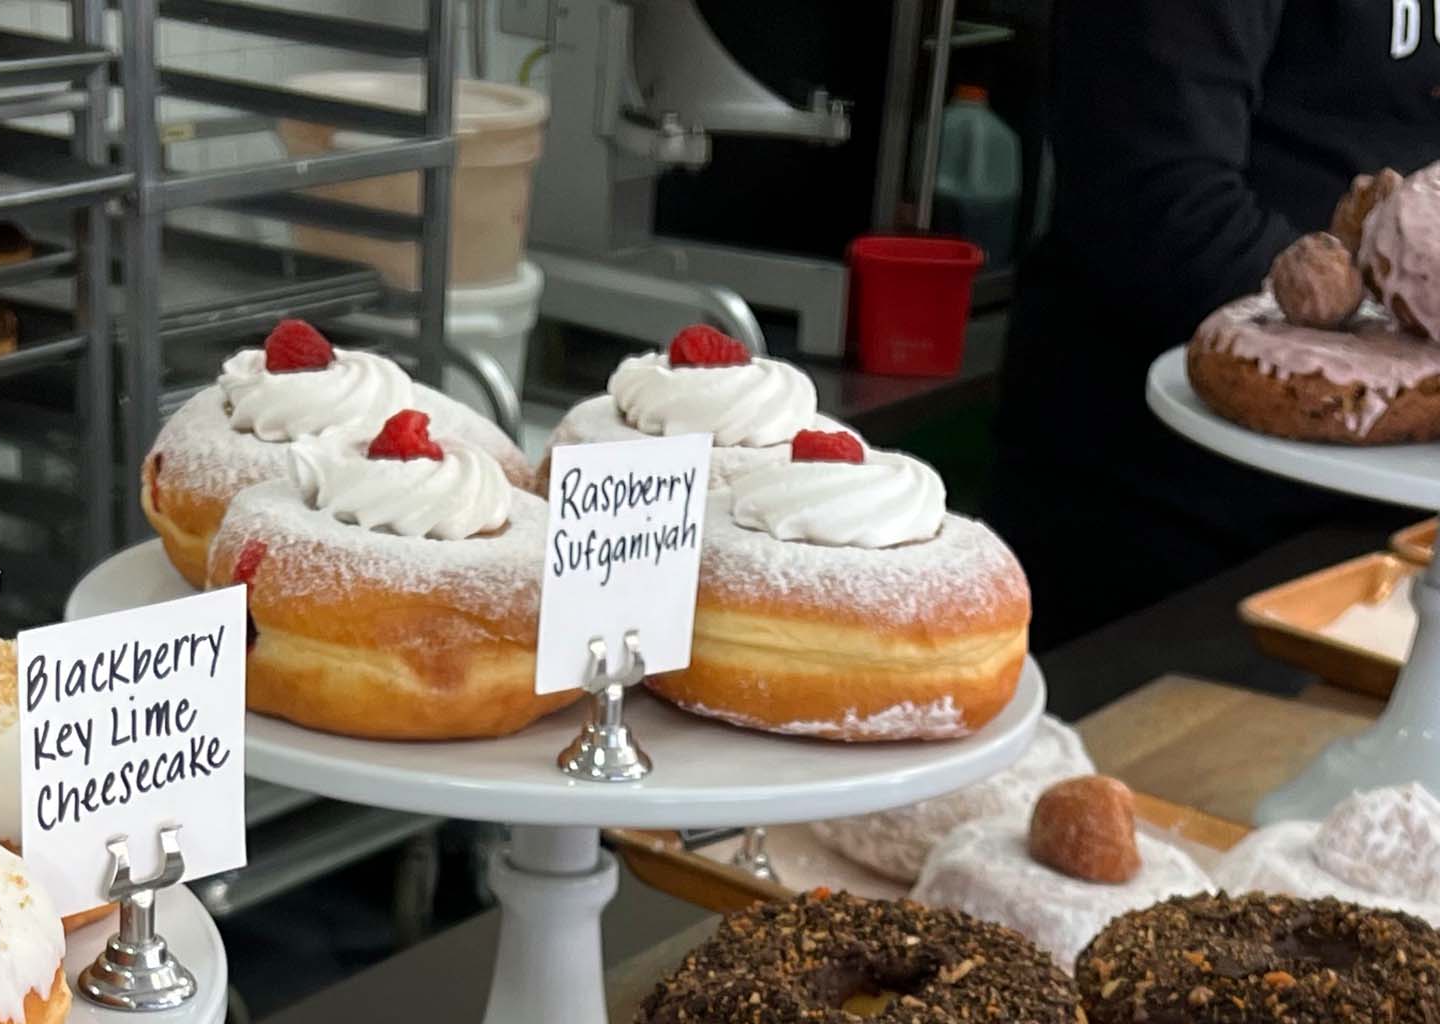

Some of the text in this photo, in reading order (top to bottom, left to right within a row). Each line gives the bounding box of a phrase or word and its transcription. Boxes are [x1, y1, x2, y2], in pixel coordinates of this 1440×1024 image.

[561, 467, 696, 521] Raspberry
[553, 516, 696, 586] Sufganiyah
[27, 625, 225, 712] Blackberry
[34, 695, 198, 770] Key Lime
[37, 735, 230, 830] Cheesecake
